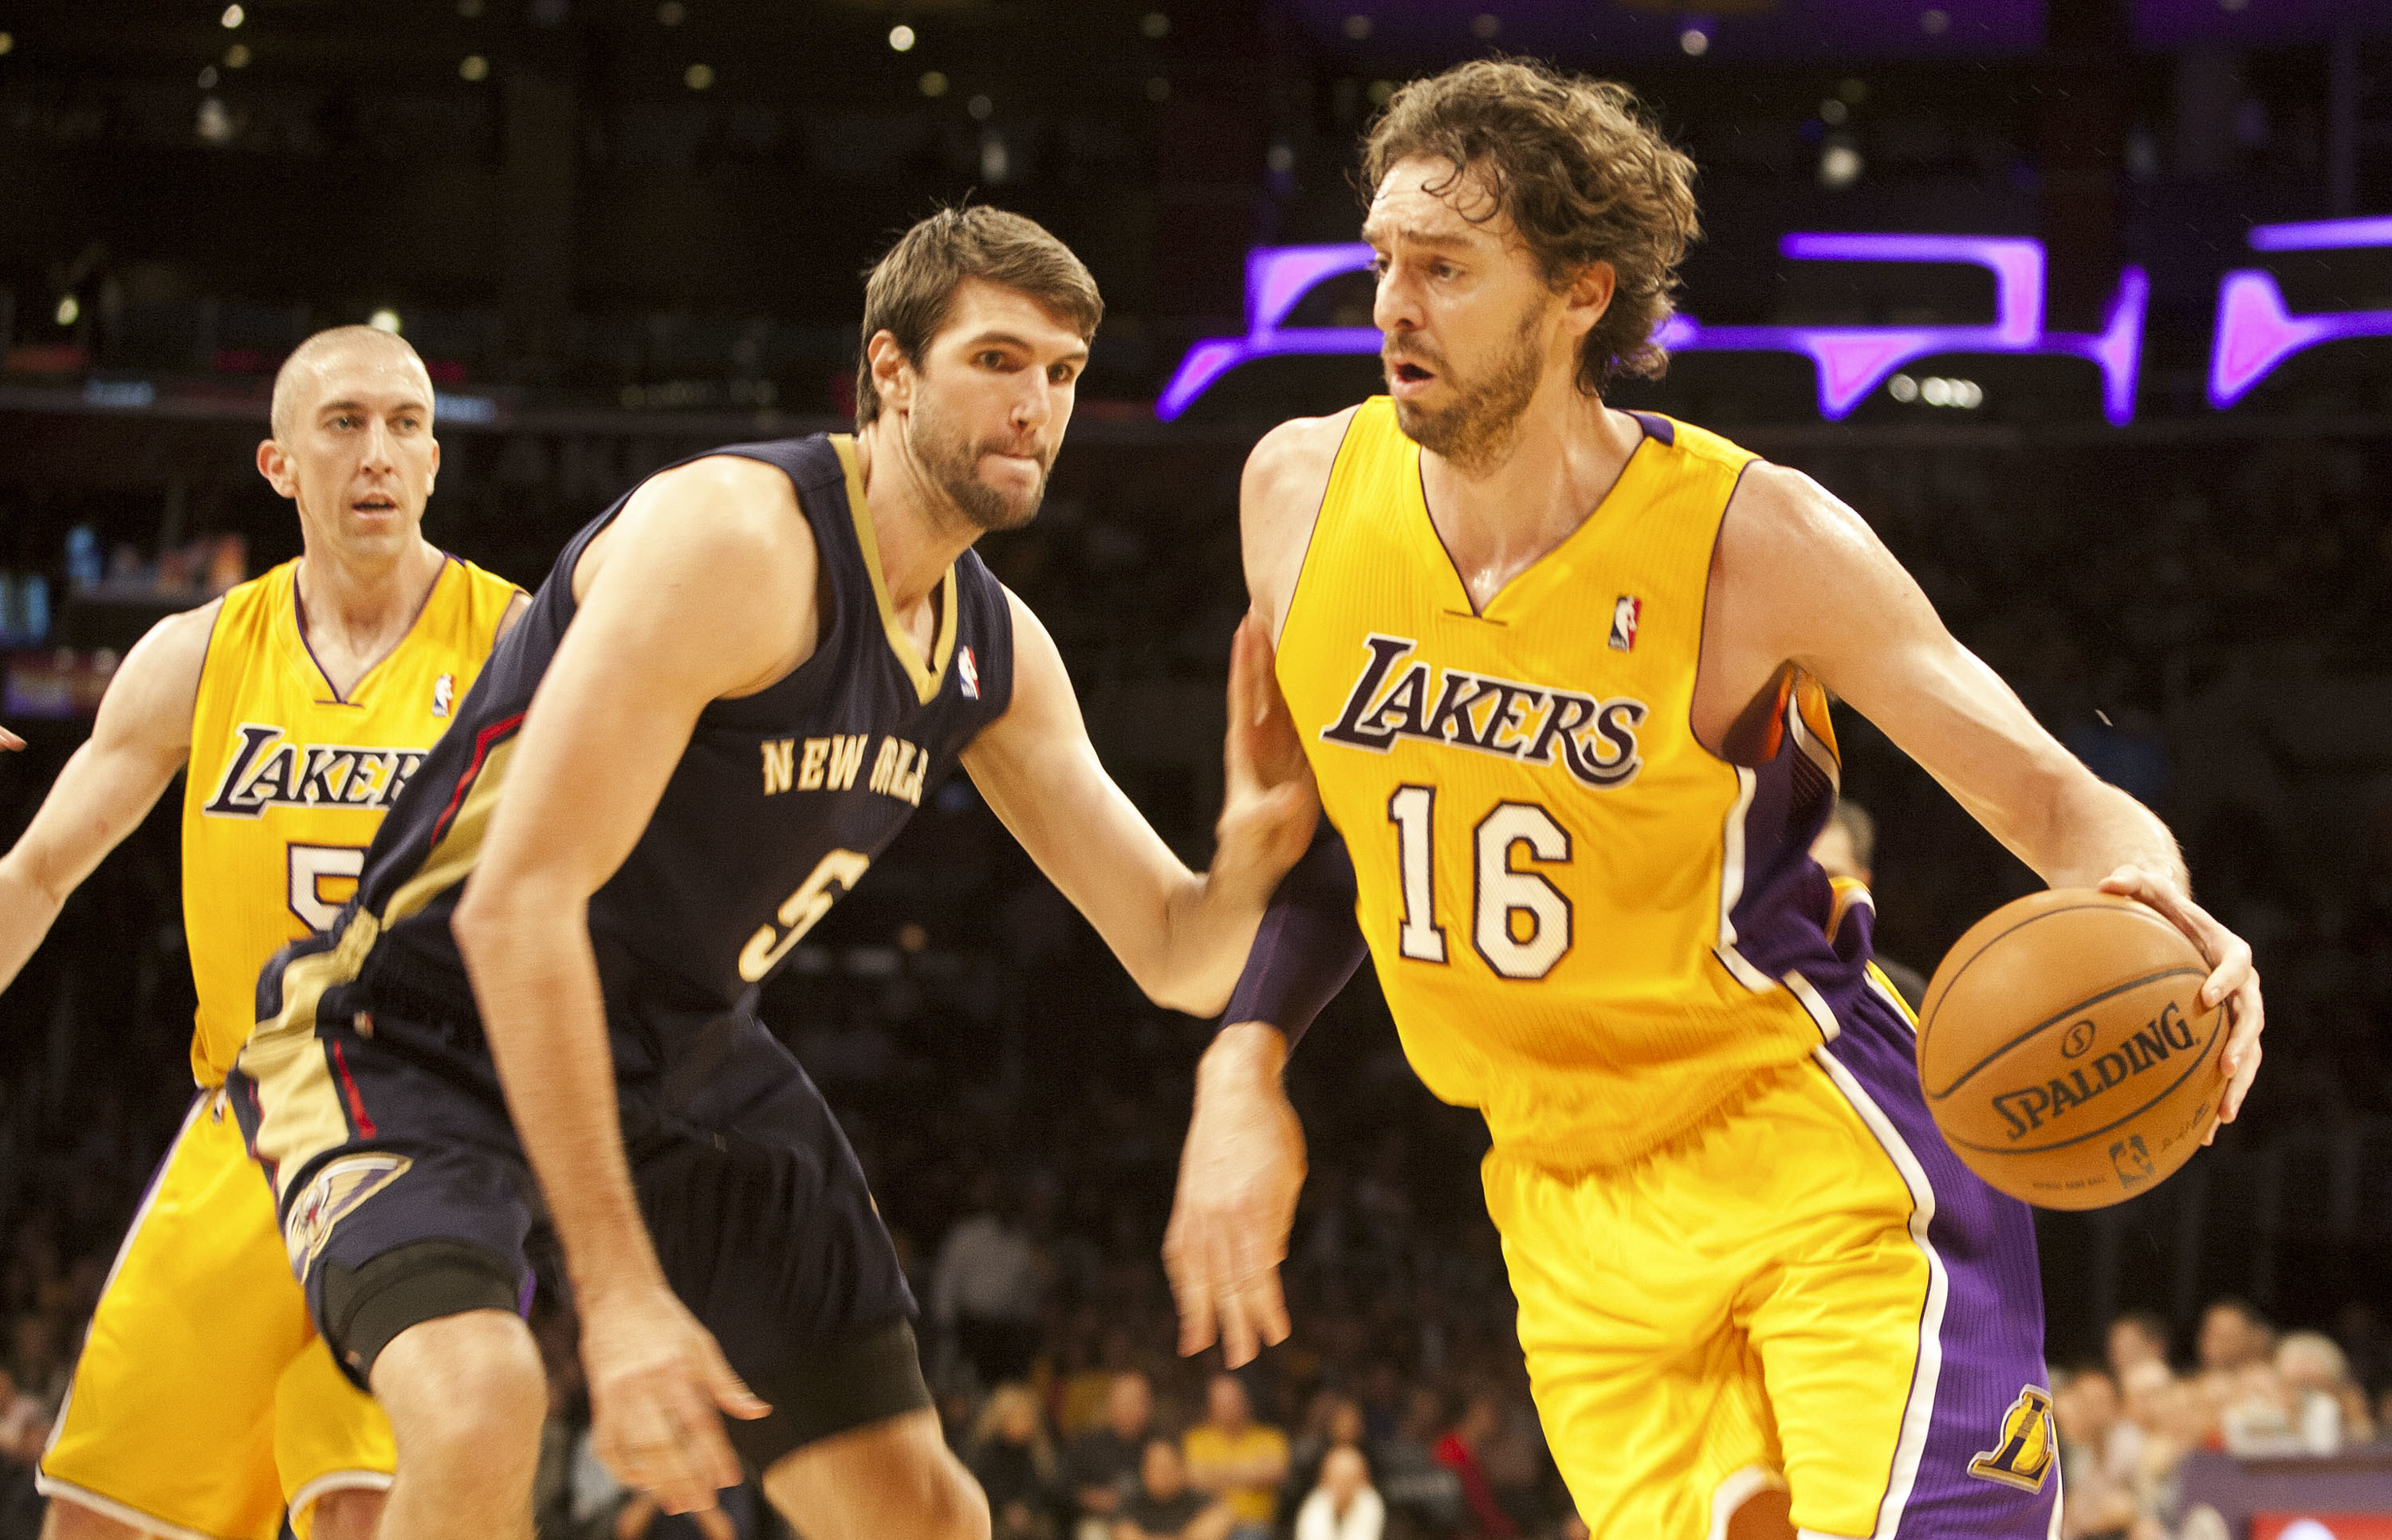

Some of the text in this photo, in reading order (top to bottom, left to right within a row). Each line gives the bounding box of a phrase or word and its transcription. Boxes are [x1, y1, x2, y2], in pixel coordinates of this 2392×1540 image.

[761, 733, 869, 796] NEW
[1320, 631, 1649, 791] LAKERS
[738, 847, 871, 983] 5
[1387, 783, 1575, 981] 16
[1993, 1000, 2195, 1141] SPALDING
